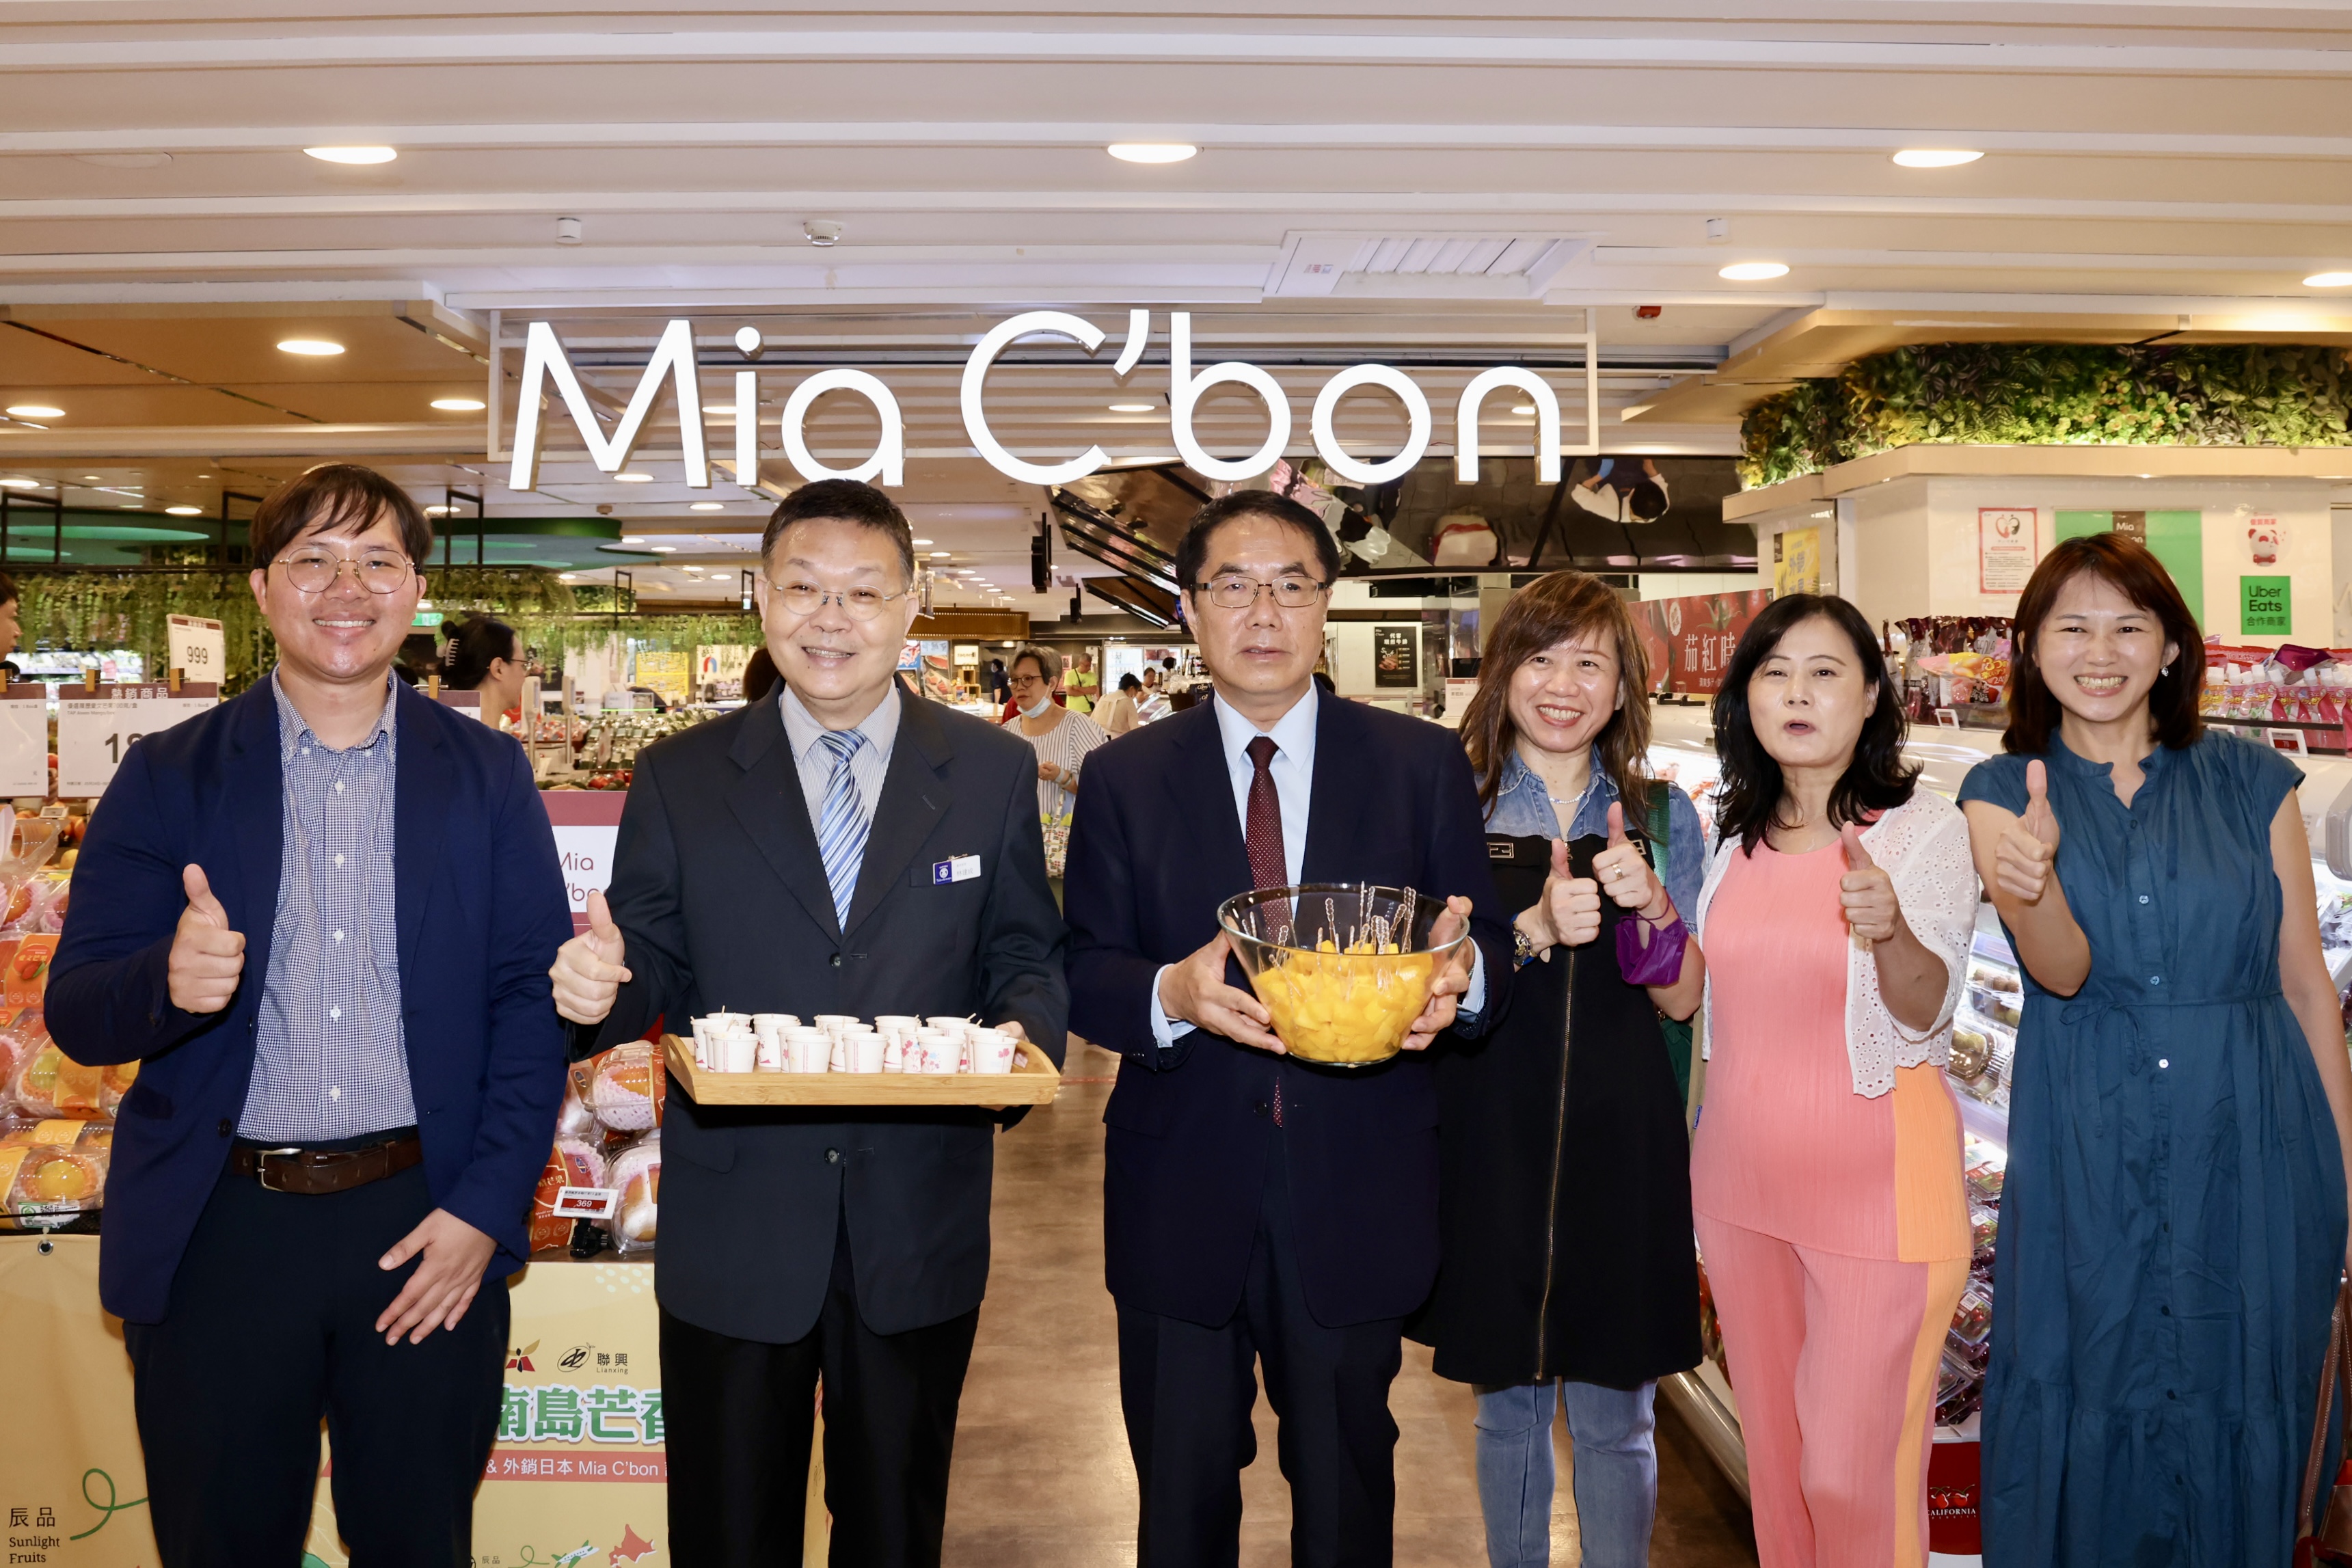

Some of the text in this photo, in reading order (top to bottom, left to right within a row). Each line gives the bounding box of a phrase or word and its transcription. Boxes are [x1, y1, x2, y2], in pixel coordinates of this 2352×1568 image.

[509, 309, 1561, 490] Mia C'bon
[2116, 522, 2135, 530] Mia
[2249, 586, 2282, 597] Uber
[2249, 600, 2282, 612] Eats
[2247, 617, 2286, 626] 合作商家
[187, 646, 208, 664] 999
[111, 688, 169, 699] 熱銷商品
[105, 733, 144, 763] 1
[597, 1353, 627, 1366] 聯興
[486, 1459, 498, 1474] &
[503, 1458, 573, 1476] 外銷日本
[578, 1461, 607, 1475] Mia
[612, 1461, 659, 1476] C'bon
[9, 1507, 55, 1528] 辰品
[9, 1535, 60, 1550] Sunlight
[9, 1552, 46, 1564] Fruits
[482, 1556, 500, 1565] 辰品
